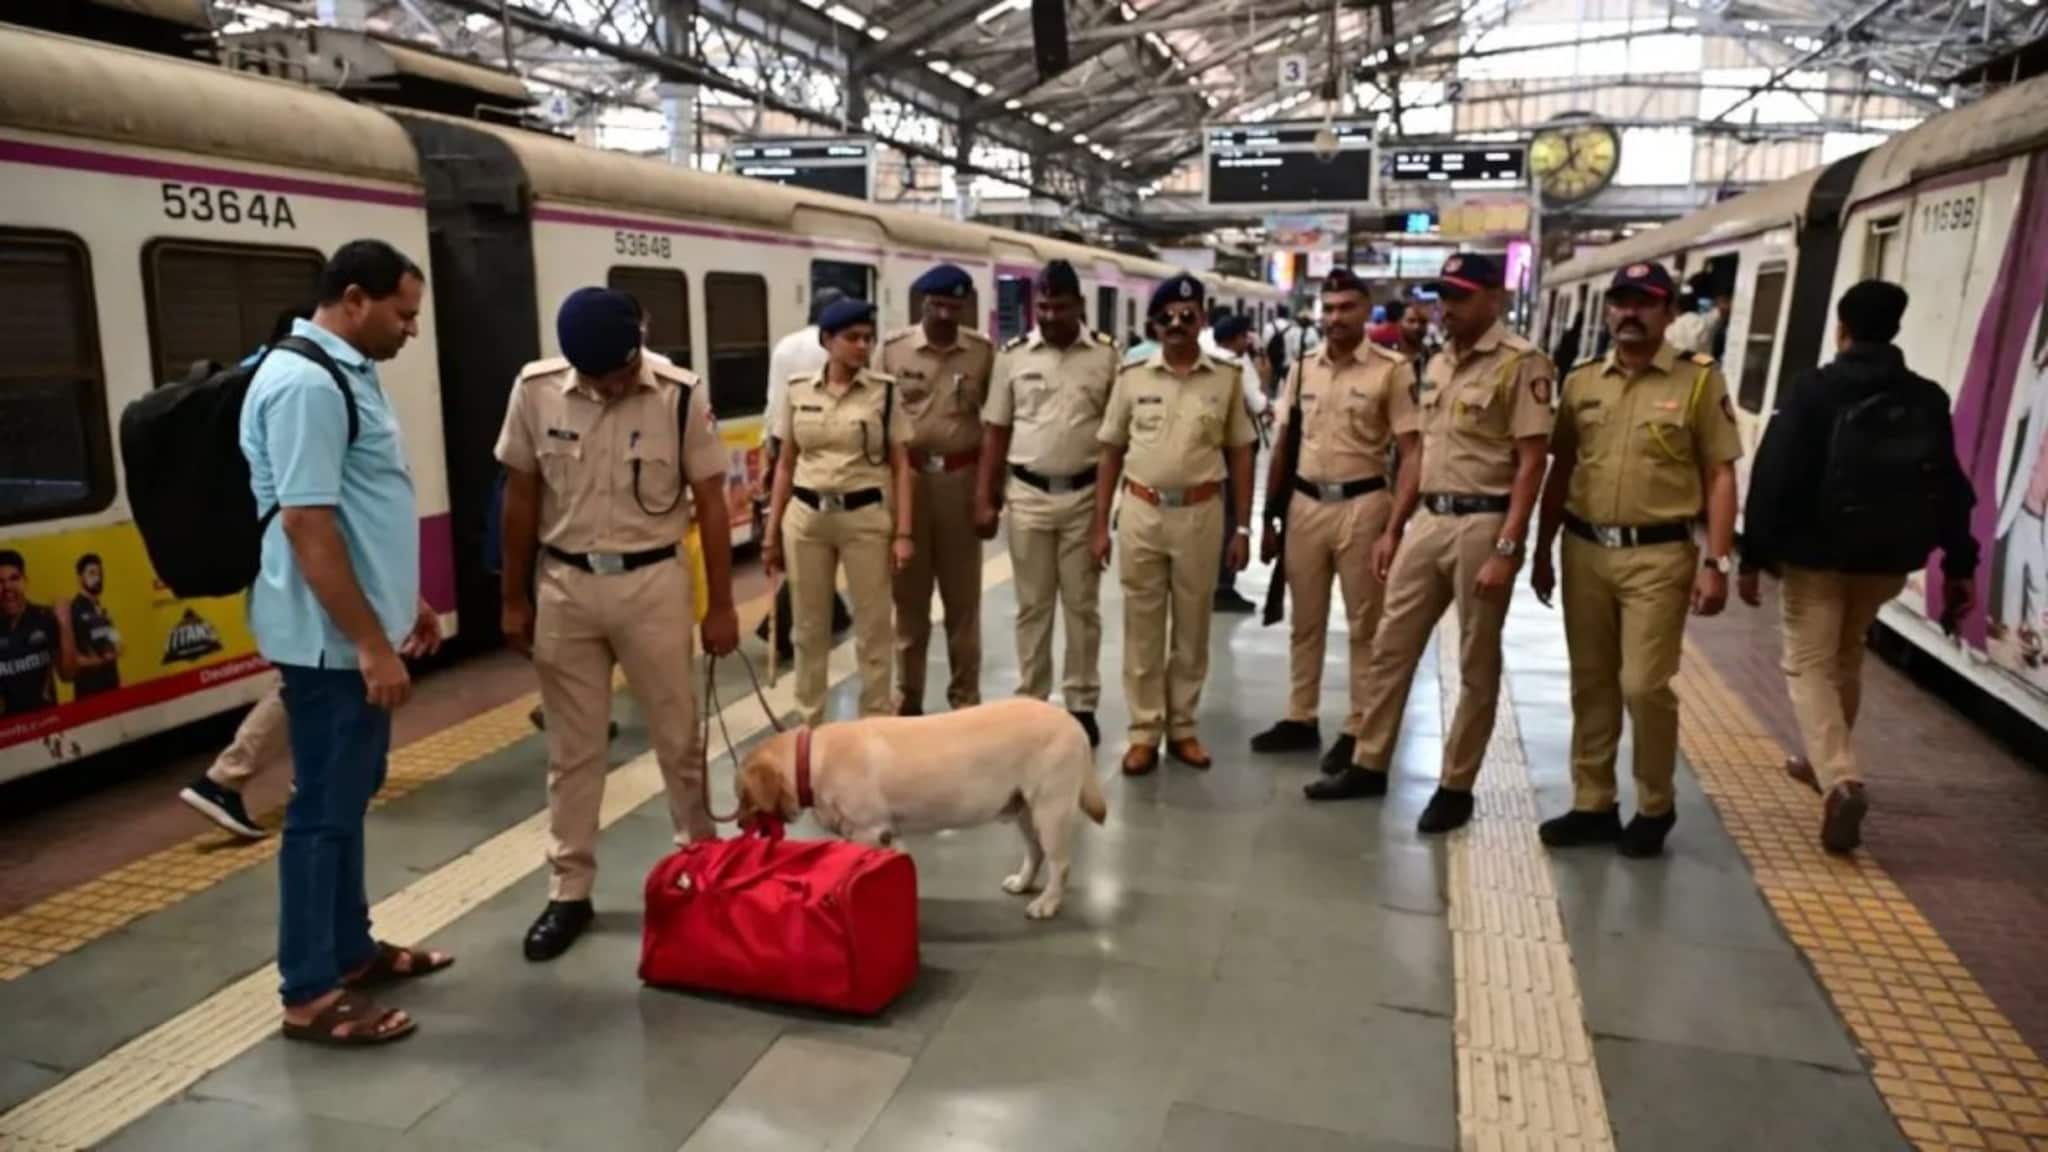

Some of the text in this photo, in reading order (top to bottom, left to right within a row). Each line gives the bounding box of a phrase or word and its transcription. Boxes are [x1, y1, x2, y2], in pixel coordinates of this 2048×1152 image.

[1285, 60, 1300, 82] 3
[1447, 81, 1463, 102] 2
[162, 183, 297, 229] 5364A
[615, 231, 672, 260] 5364B
